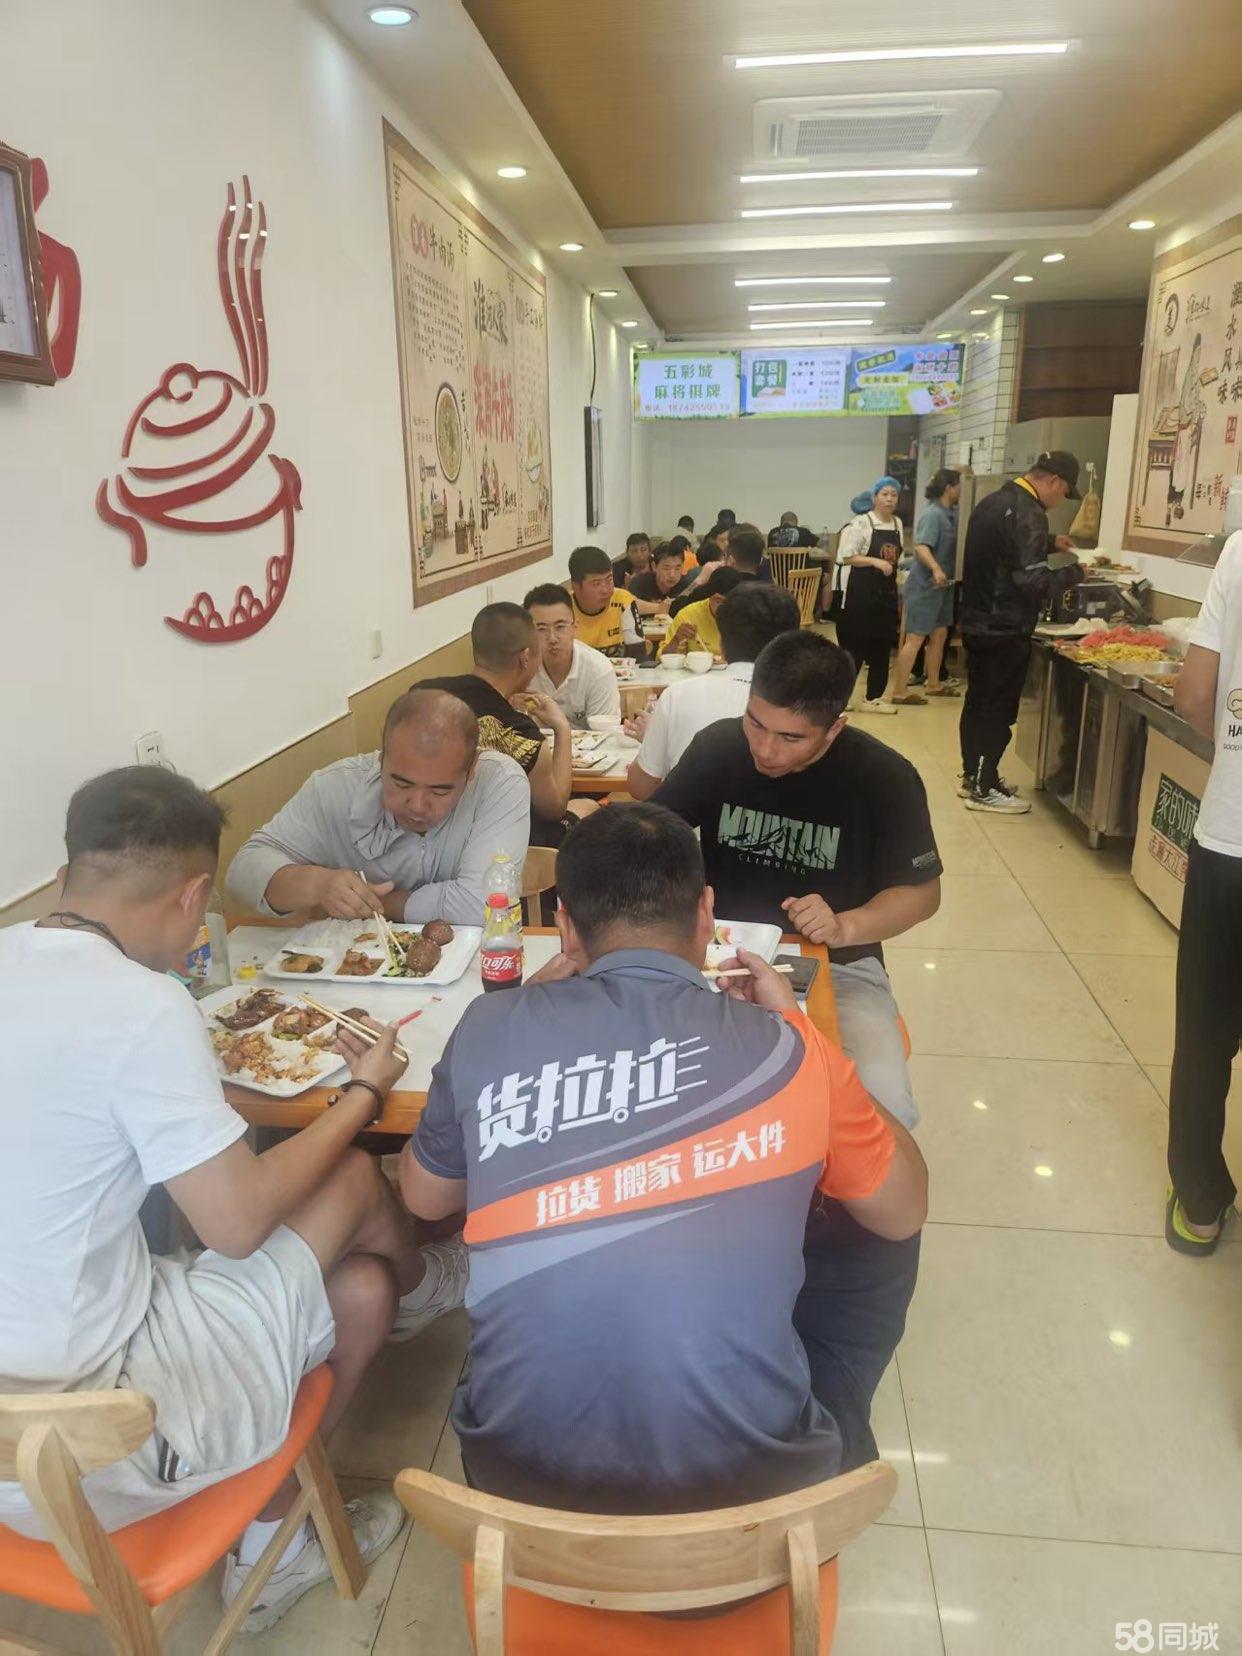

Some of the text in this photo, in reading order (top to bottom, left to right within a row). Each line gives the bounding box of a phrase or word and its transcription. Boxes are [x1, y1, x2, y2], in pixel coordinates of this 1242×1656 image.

[655, 384, 720, 399] 麻将棋牌
[664, 364, 713, 379] 五彩城
[718, 802, 841, 870] MOUNTAIN
[738, 854, 806, 876] CLIMBING
[477, 1037, 679, 1162] 货拉拉
[536, 1119, 787, 1227] 拉货 搬家 运大件
